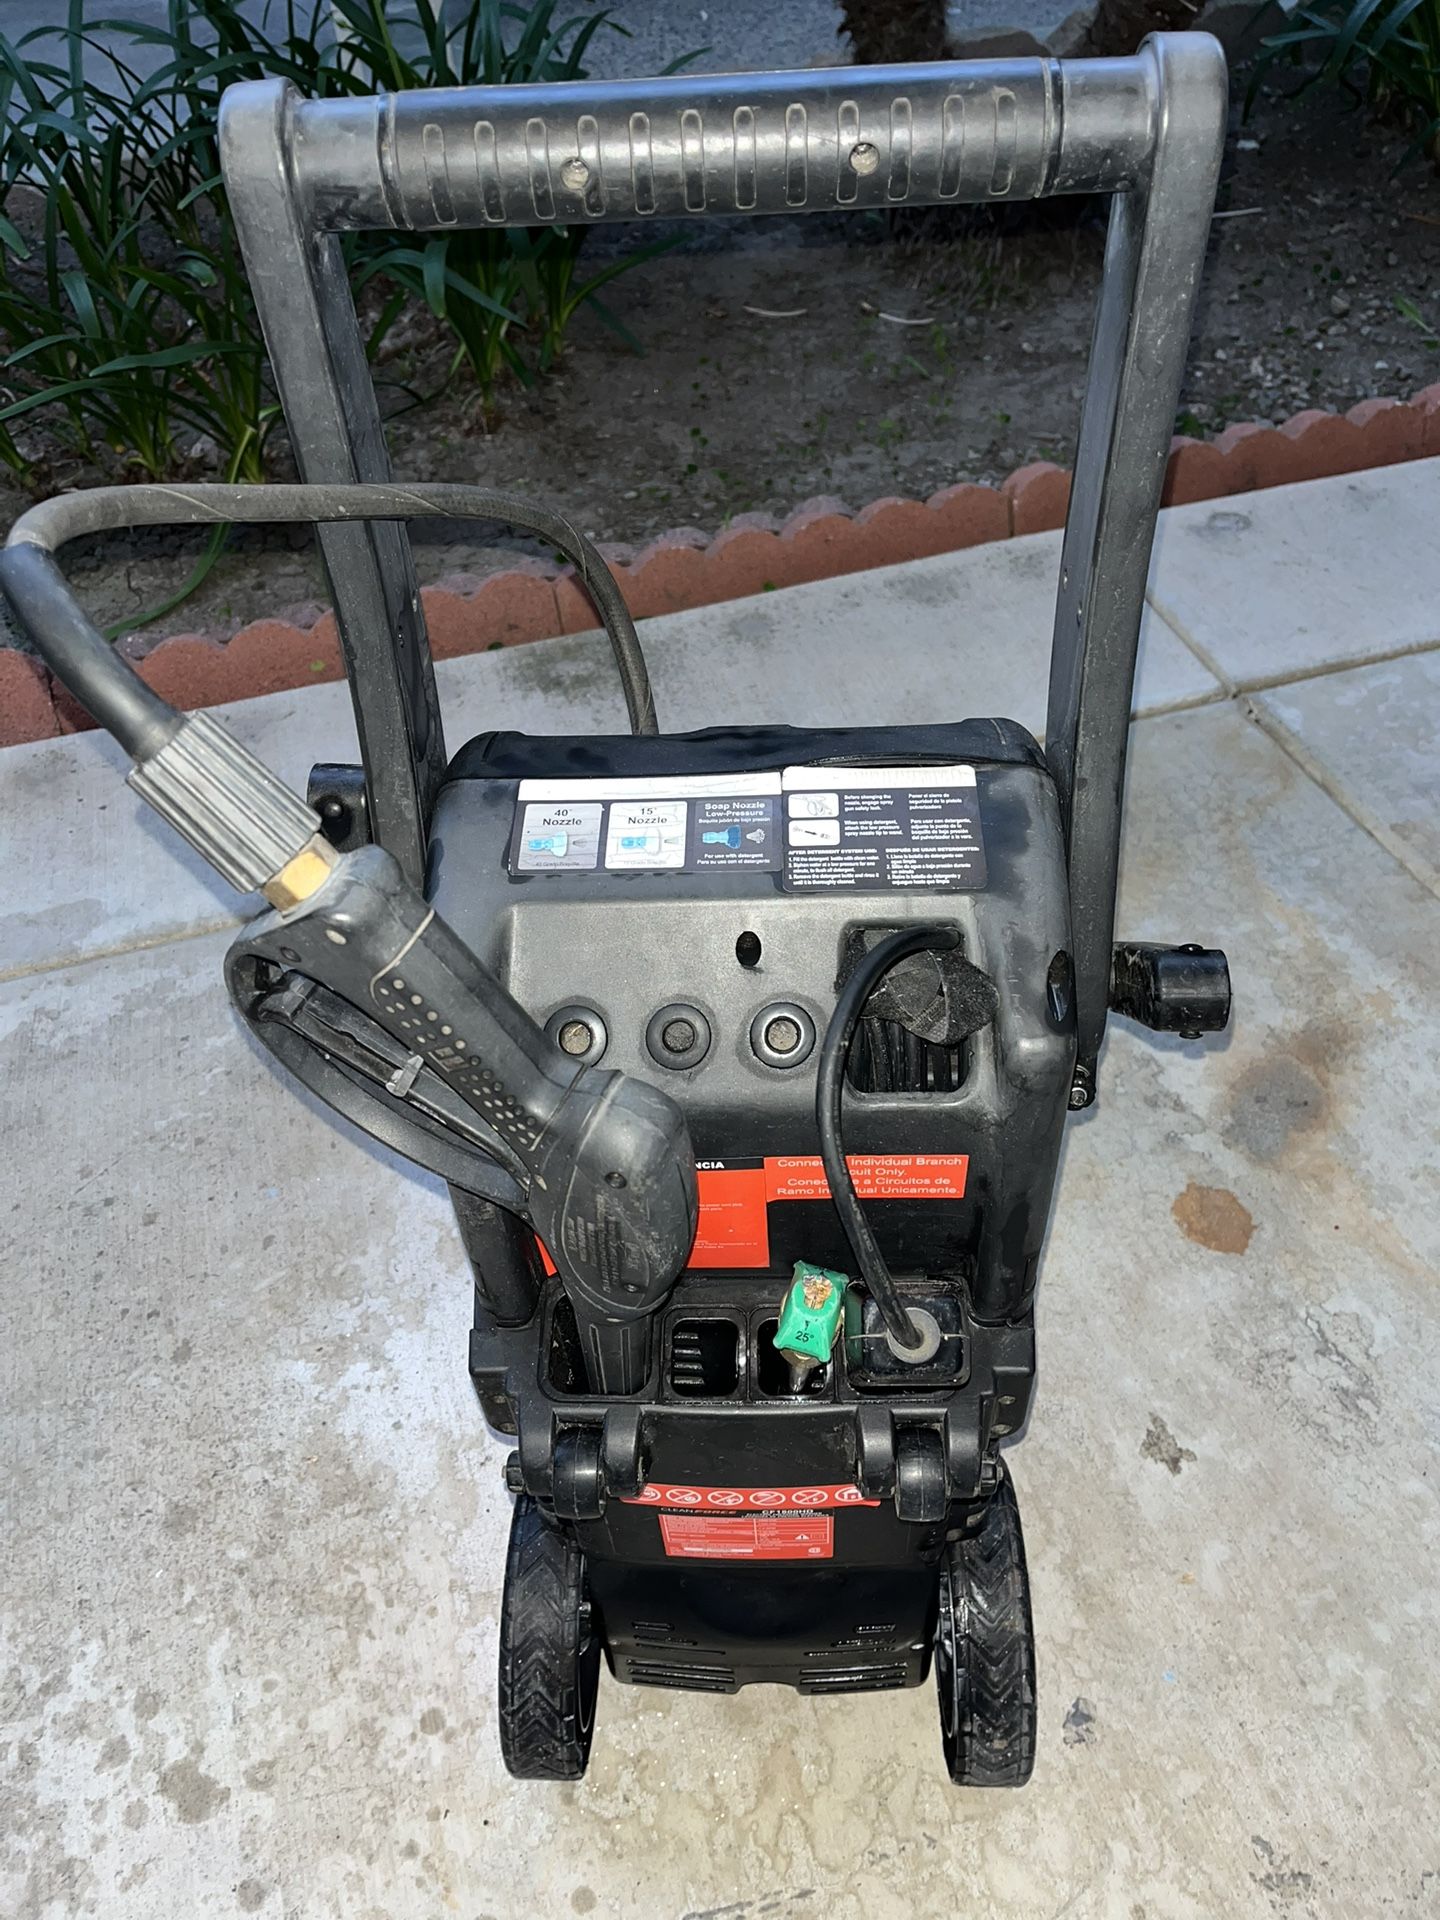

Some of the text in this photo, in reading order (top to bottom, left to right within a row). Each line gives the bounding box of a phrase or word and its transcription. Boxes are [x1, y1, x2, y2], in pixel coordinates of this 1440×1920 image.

[851, 1158, 912, 1166] Individual
[916, 1157, 962, 1166] Branch
[875, 1168, 907, 1177] Only.
[875, 1177, 931, 1185] Circuitos
[777, 1187, 814, 1195] Ramo
[881, 1186, 960, 1194] Unicamente.
[795, 1331, 814, 1343] 25°
